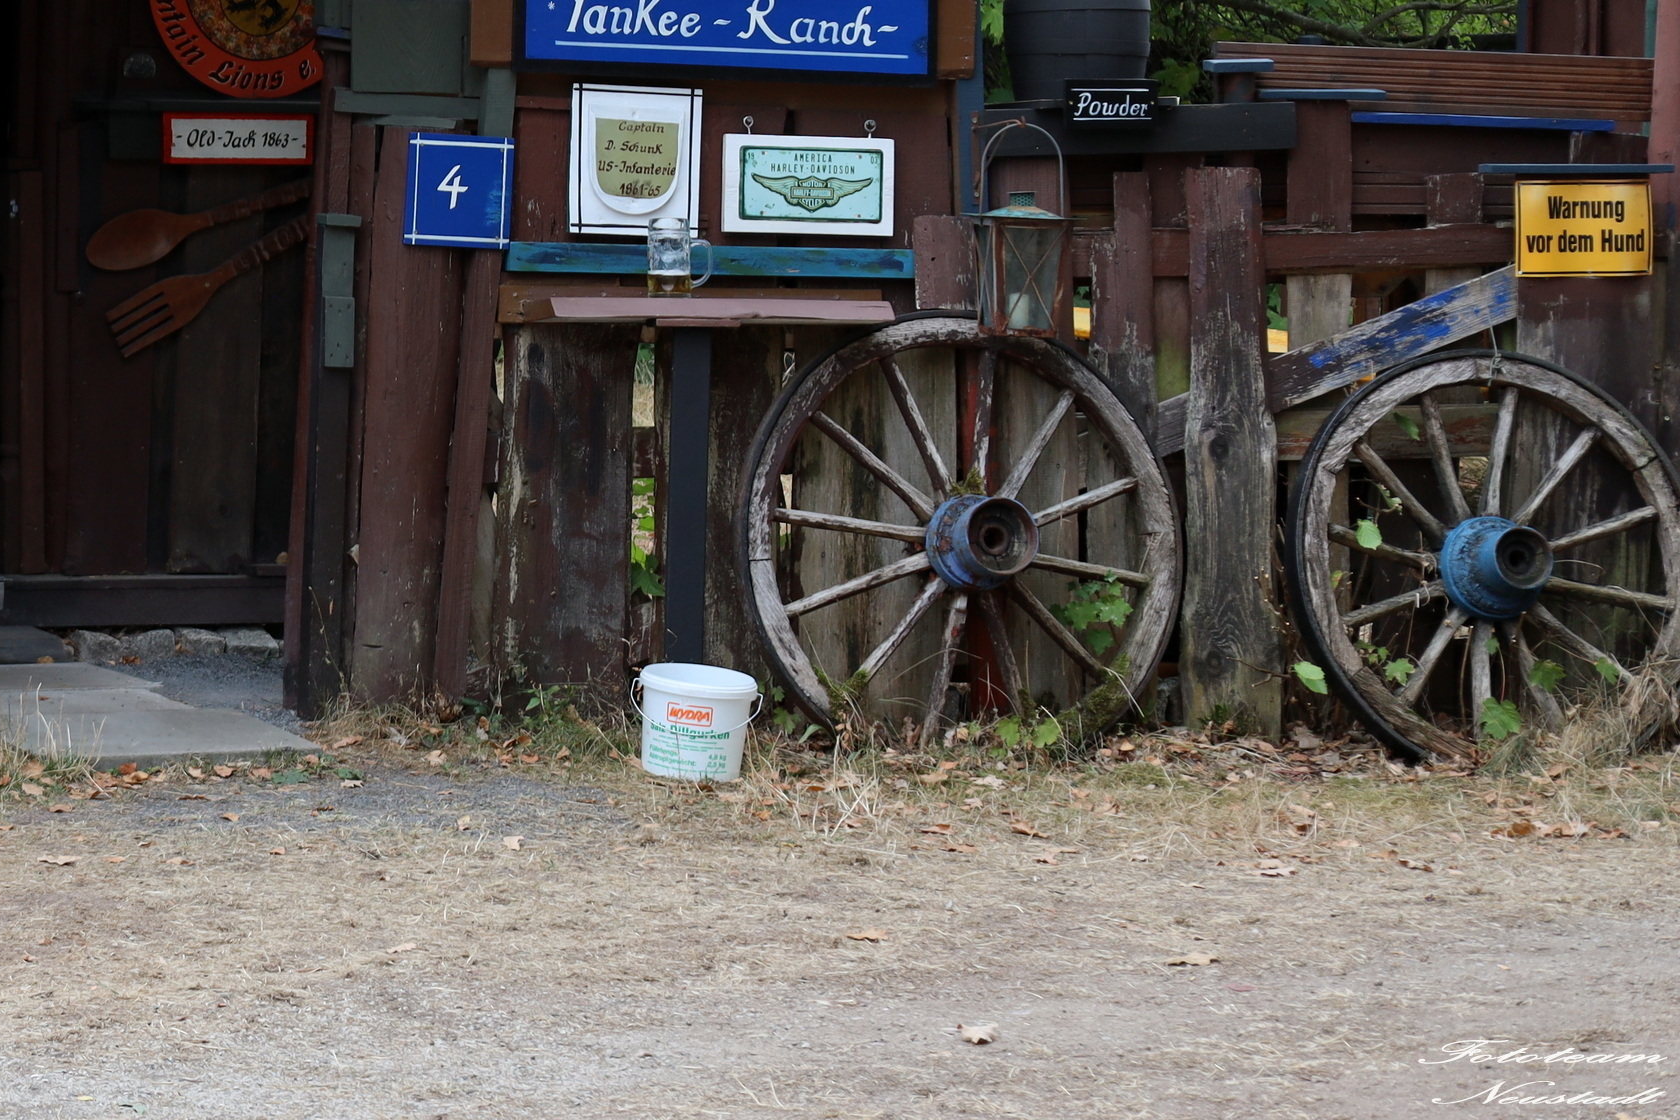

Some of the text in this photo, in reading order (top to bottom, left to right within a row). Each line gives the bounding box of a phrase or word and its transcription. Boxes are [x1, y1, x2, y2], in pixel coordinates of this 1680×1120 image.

[209, 60, 285, 91] Lions
[1074, 92, 1148, 116] Powder
[618, 121, 664, 134] Captain
[604, 139, 616, 151] D.
[794, 153, 832, 163] AMERICA
[437, 164, 469, 209] 4
[1548, 195, 1625, 222] Warnung
[1526, 229, 1645, 253] vor dem Hund
[669, 707, 710, 722] WYDRA
